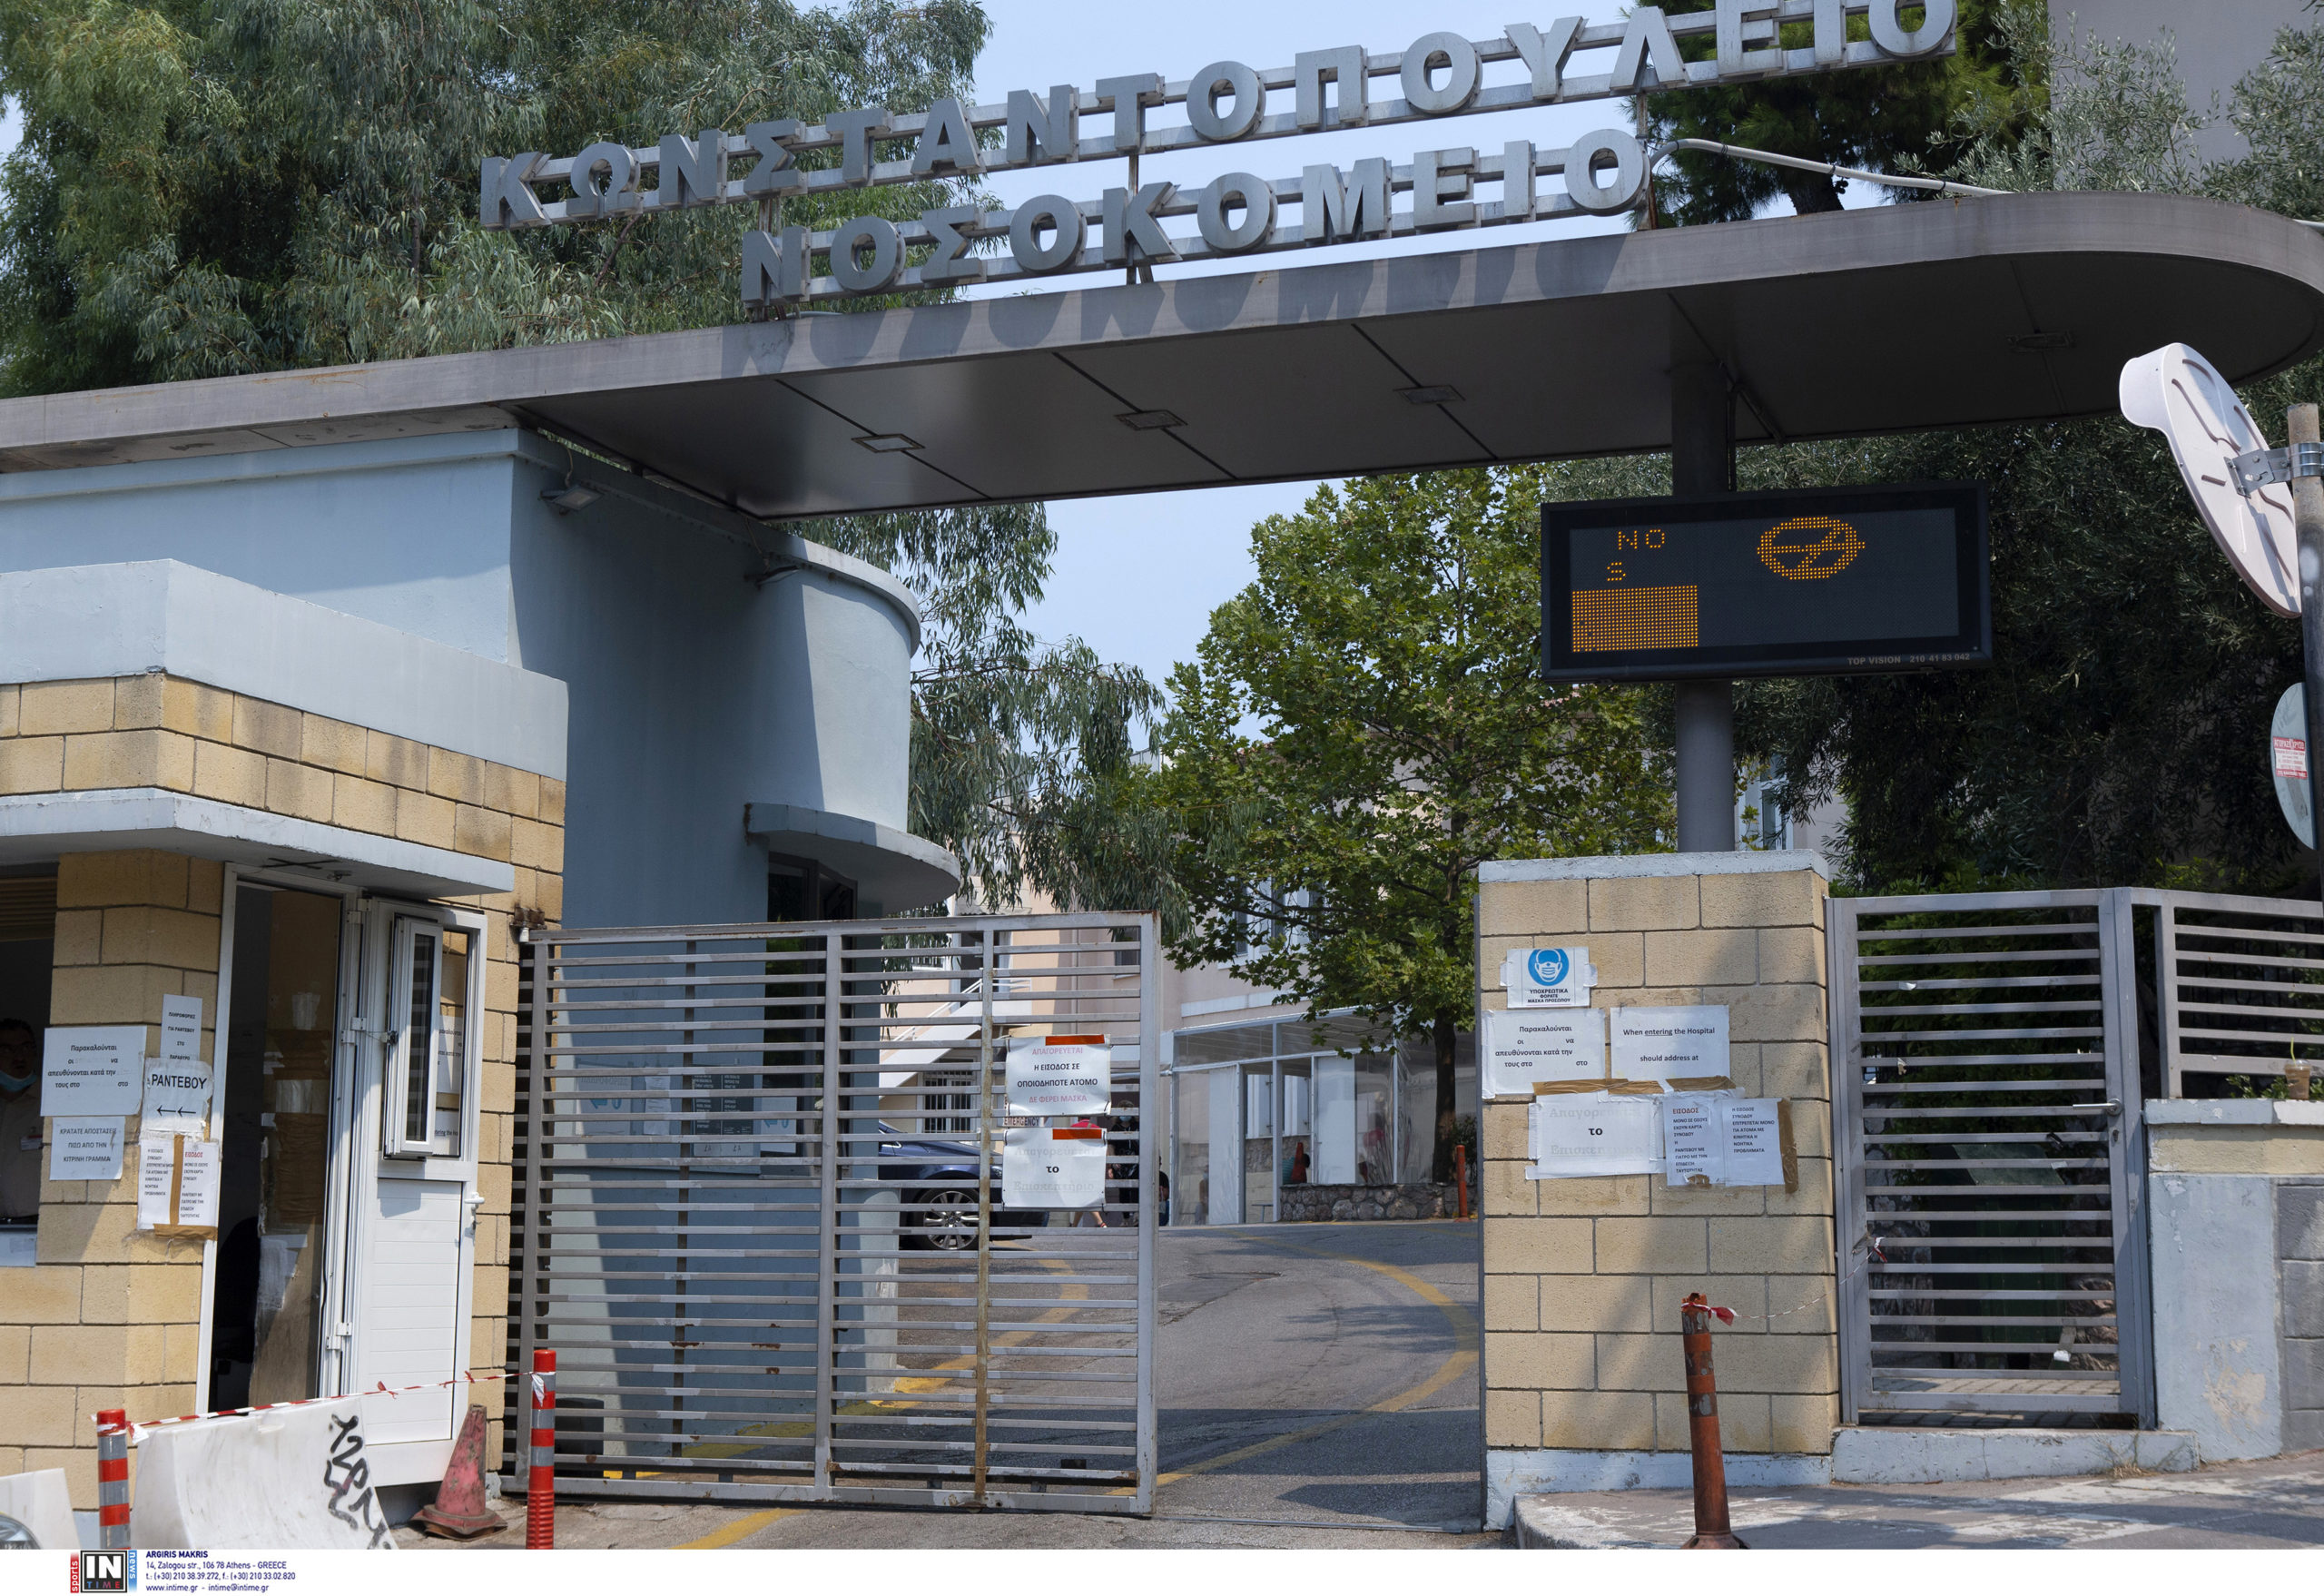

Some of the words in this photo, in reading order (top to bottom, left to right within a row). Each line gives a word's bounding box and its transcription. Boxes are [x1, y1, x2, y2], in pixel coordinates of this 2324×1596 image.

[480, 0, 1957, 230] ΚΩΝΣΤΑΝΤΟΠΟΥΛΕΙΟ
[741, 129, 1649, 304] ΝΟΣΟΚΟΜΕΙΟ
[1846, 656, 1866, 665] TOP
[1868, 655, 1901, 665] VISION
[1909, 655, 1925, 663] 210
[1941, 654, 1953, 662] 83
[1954, 653, 1970, 661] 042
[1519, 1025, 1572, 1033] Παρακαλούνται
[1644, 1028, 1673, 1037] entering
[1687, 1026, 1715, 1036] Hospital
[70, 1043, 117, 1052] Παρακαλούνται
[1031, 1047, 1083, 1055] ΑΠΑΓΟΡΕΥΕΤΑΙ
[1495, 1049, 1542, 1057] απευθύνονται
[1640, 1054, 1663, 1062] should
[1663, 1054, 1690, 1062] address
[1040, 1063, 1070, 1071] ΕΙΣΟΔΟΣ
[1071, 1062, 1080, 1070] ΣΕ
[1504, 1061, 1521, 1069] τους
[47, 1069, 89, 1078] απευθύνονται
[90, 1068, 105, 1076] κατά
[105, 1069, 117, 1079] την
[54, 1081, 69, 1089] τους
[151, 1073, 208, 1089] ΡΑΝΤΕΒΟΥ
[1017, 1079, 1068, 1088] ΟΠΟΙΟΔΗΠΟΤΕ
[1069, 1078, 1098, 1087] ΑΤΟΜΟ
[1039, 1095, 1059, 1103] ΦΕΡΕΙ
[1060, 1094, 1088, 1103] ΜΑΣΚΑ
[1672, 1107, 1699, 1115] ΕΙΣΟΔΟΣ
[1004, 1117, 1039, 1126] EMERGENCY
[1588, 1128, 1604, 1136] το
[1046, 1166, 1059, 1174] το
